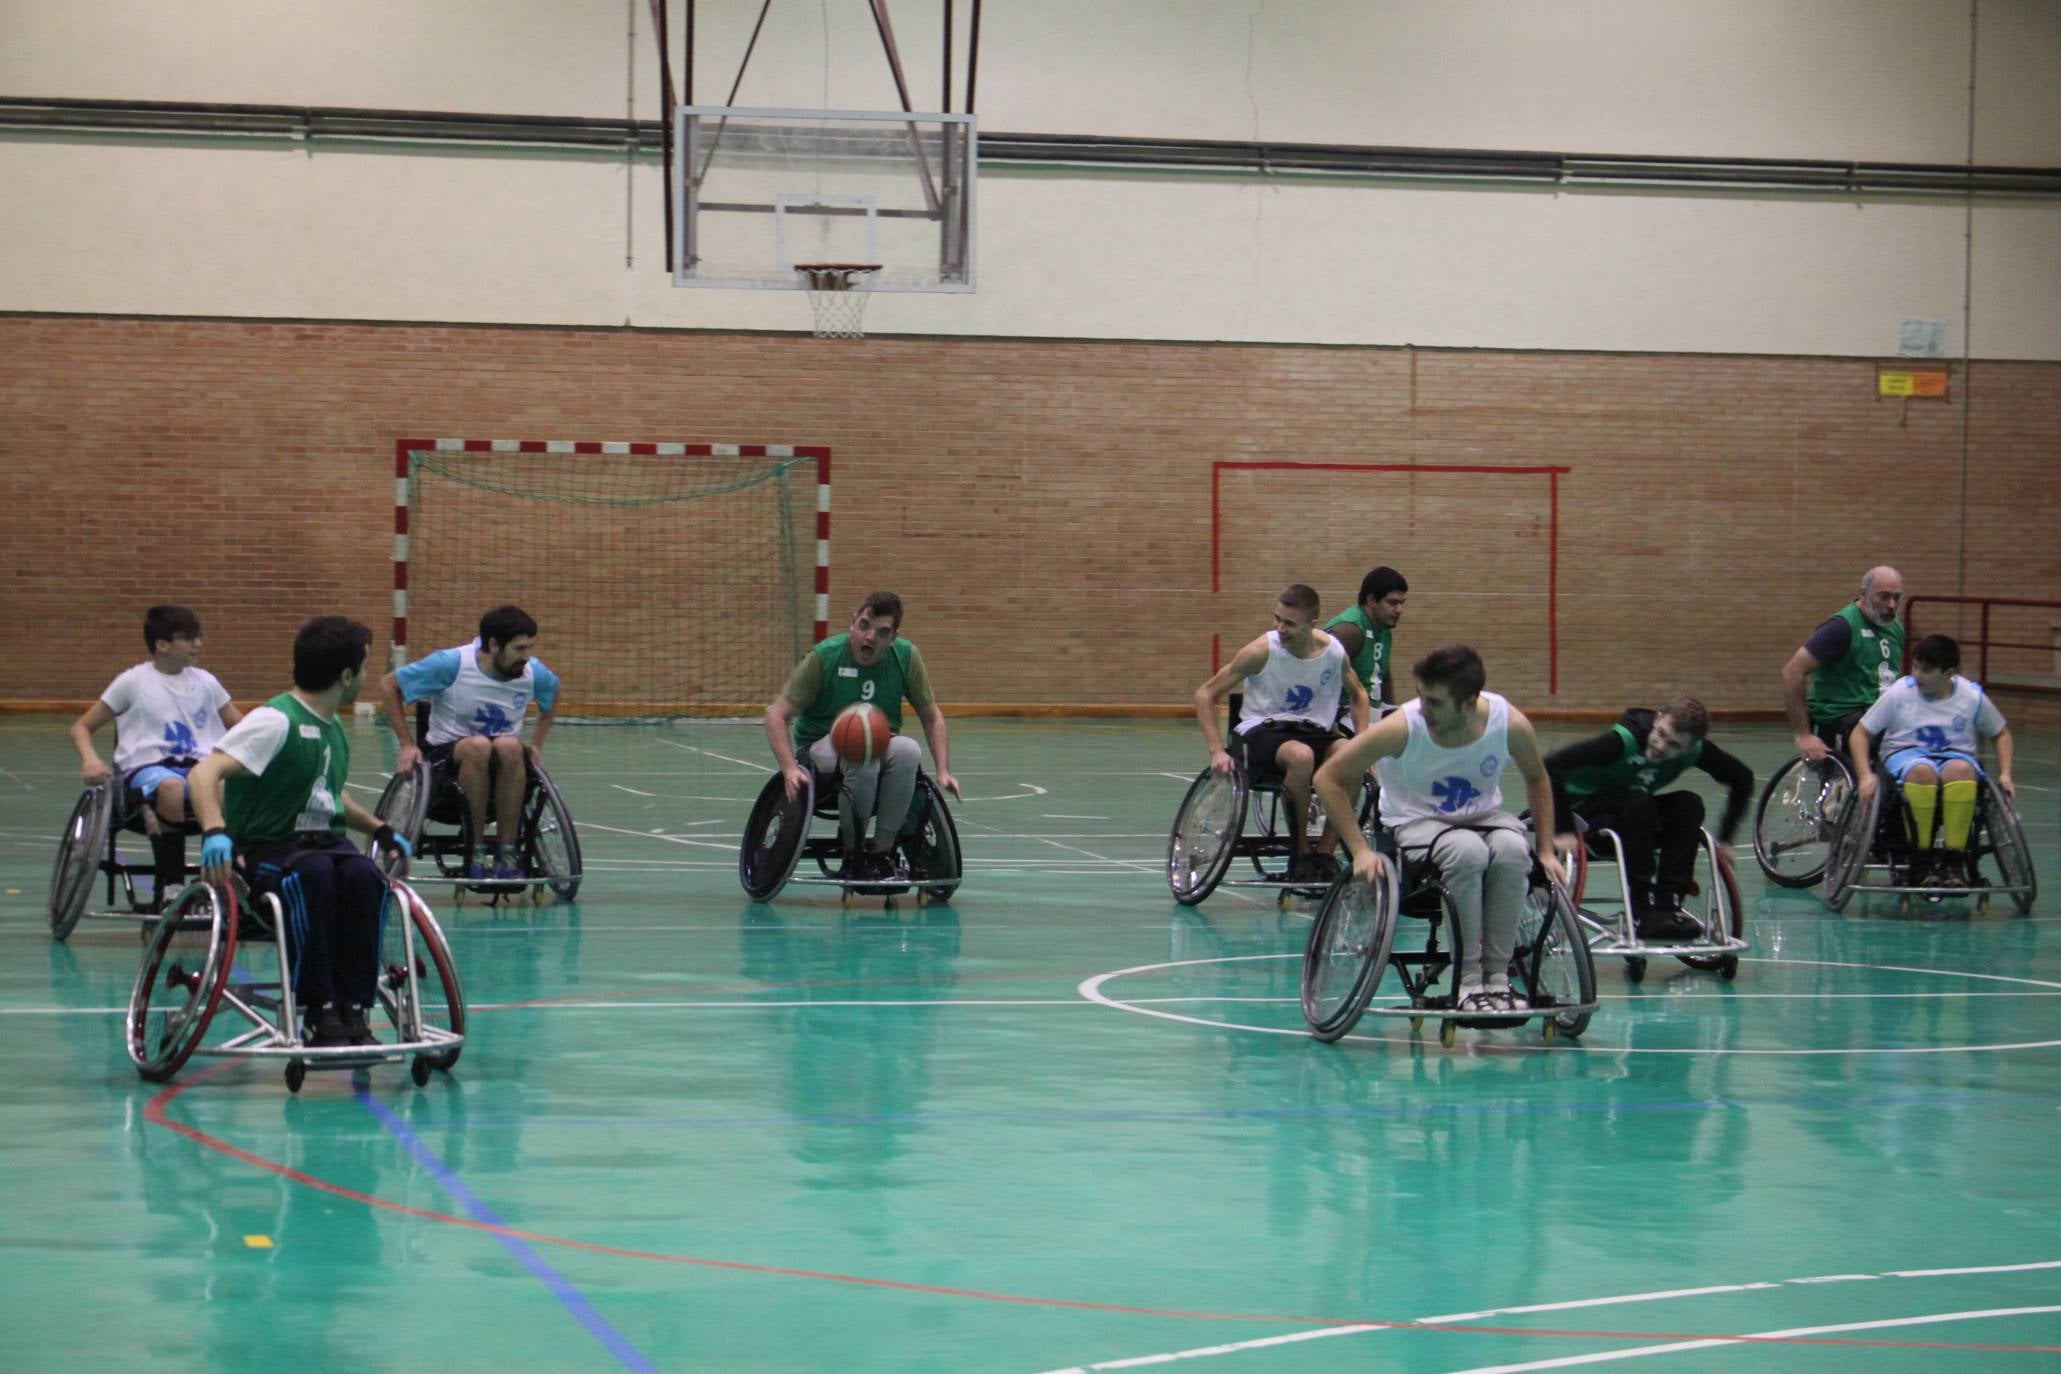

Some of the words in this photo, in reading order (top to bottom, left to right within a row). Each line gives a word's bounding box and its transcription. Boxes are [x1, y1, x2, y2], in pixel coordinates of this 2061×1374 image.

[1373, 642, 1384, 660] 8
[1880, 638, 1890, 659] 6
[861, 680, 875, 700] 9
